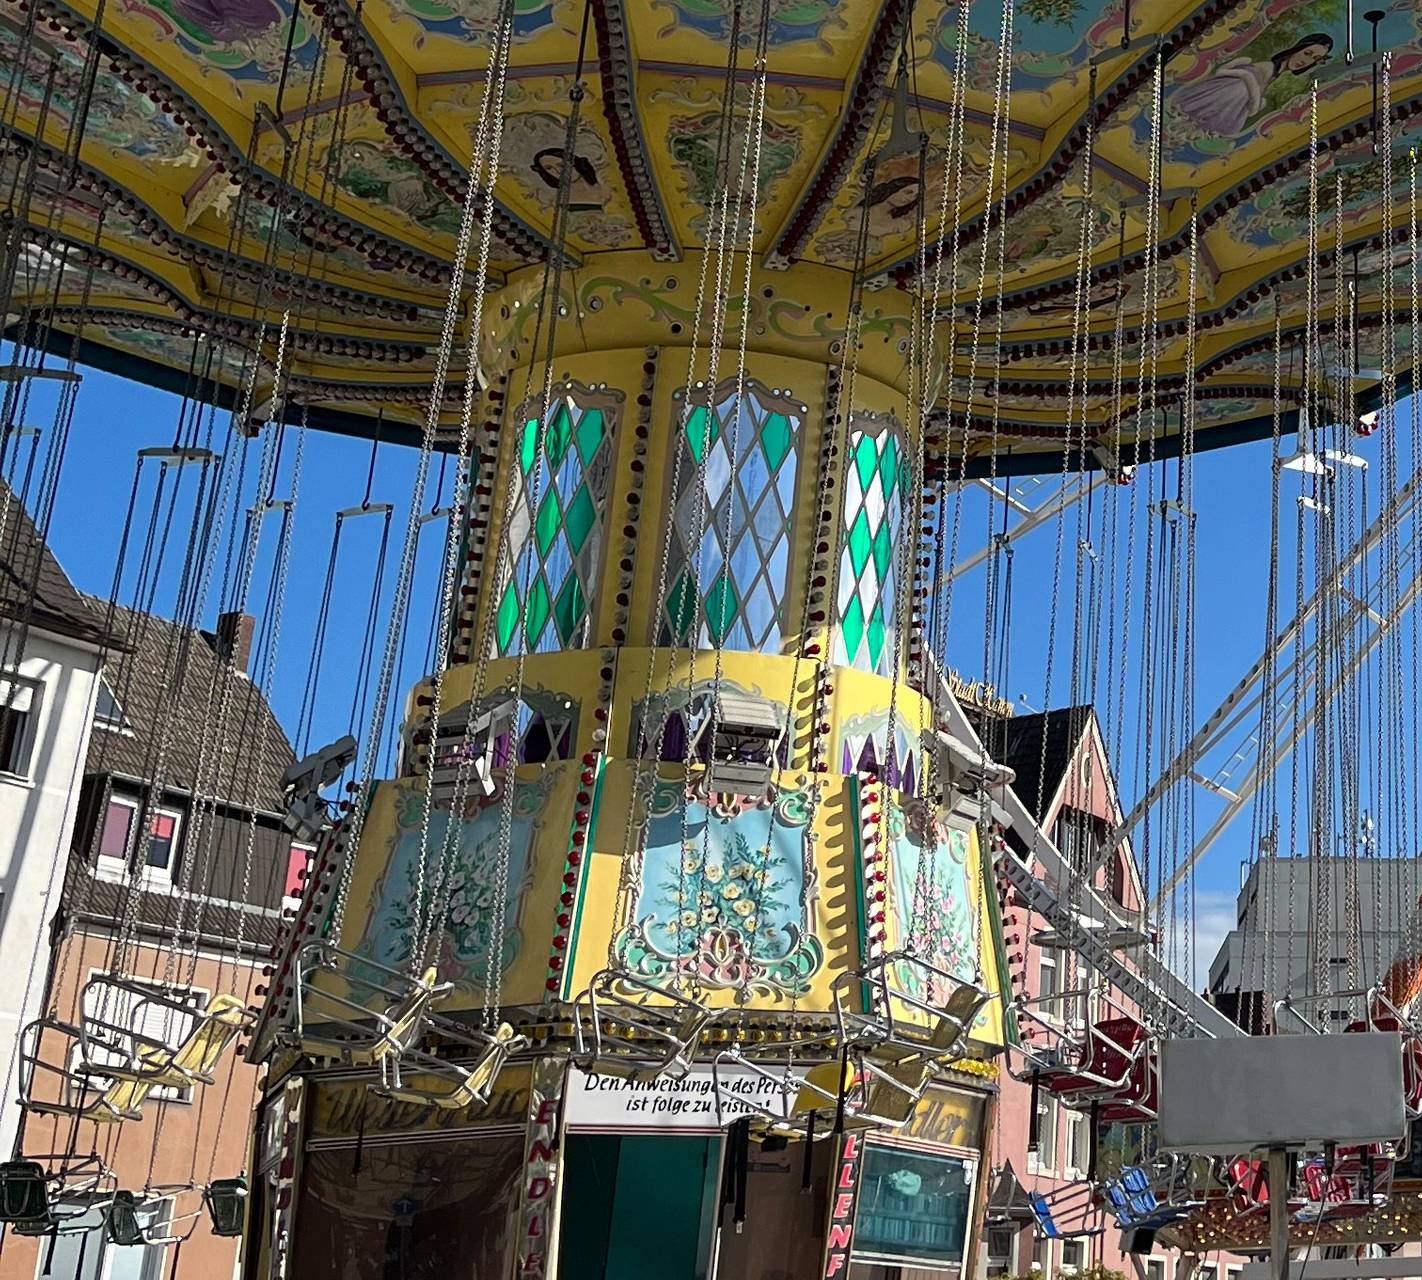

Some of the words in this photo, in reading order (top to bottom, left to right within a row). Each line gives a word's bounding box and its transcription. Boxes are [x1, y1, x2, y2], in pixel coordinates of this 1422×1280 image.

[584, 1073, 620, 1092] Den
[731, 1077, 755, 1094] des
[626, 1095, 648, 1111] ist
[652, 1096, 691, 1115] folge
[692, 1100, 711, 1112] zu
